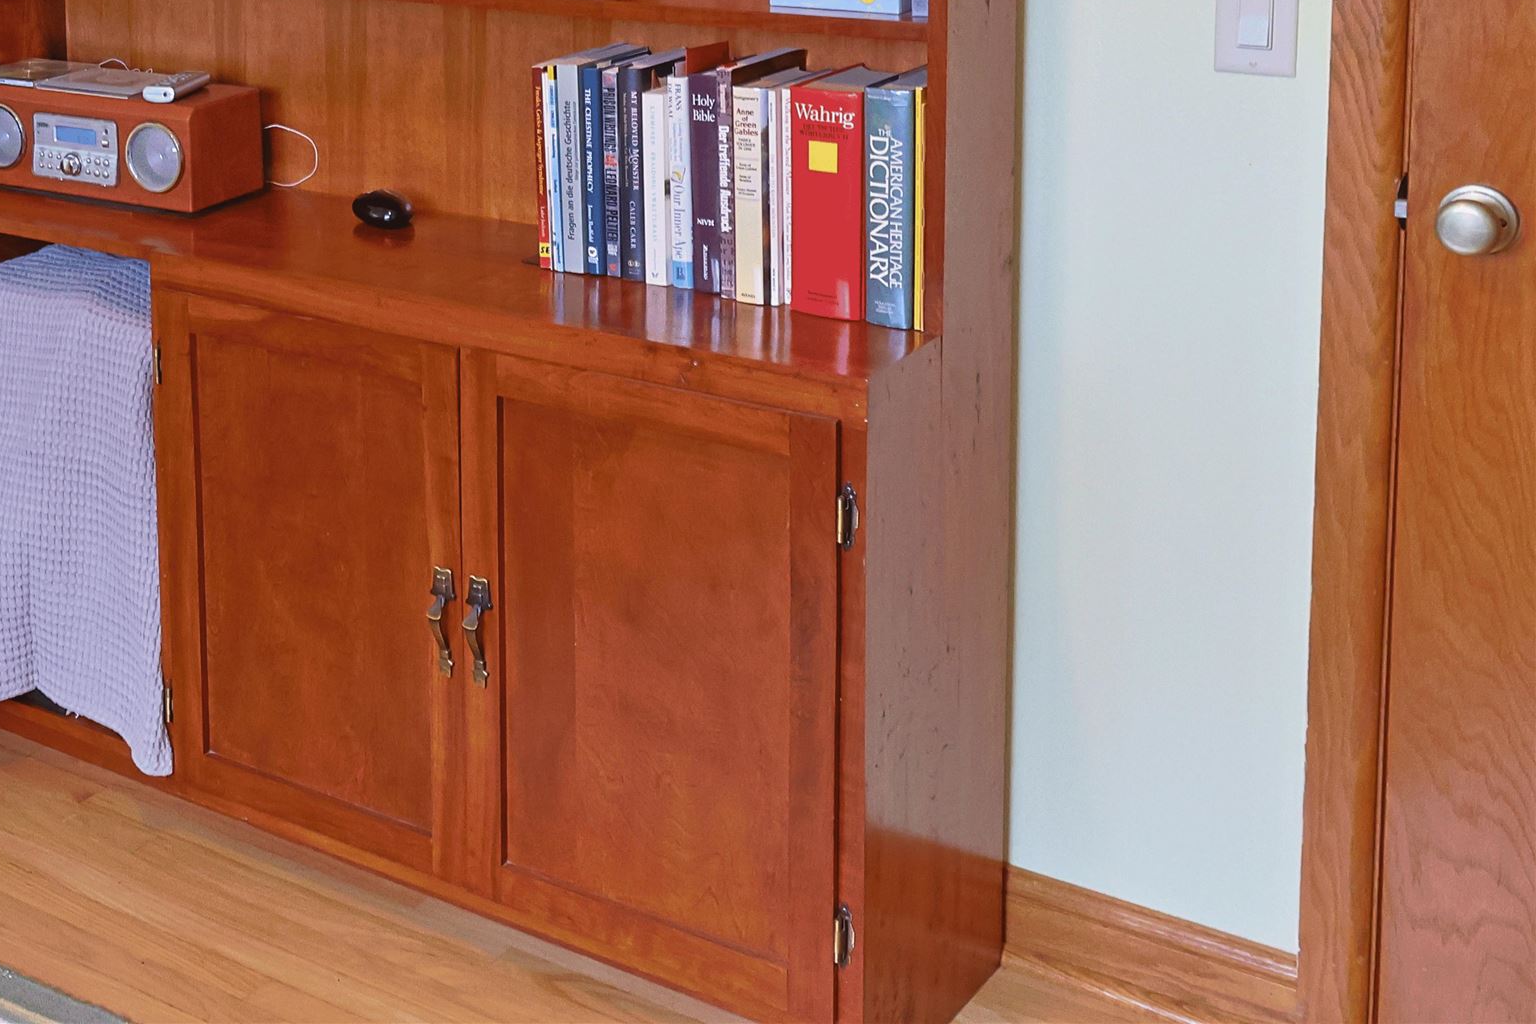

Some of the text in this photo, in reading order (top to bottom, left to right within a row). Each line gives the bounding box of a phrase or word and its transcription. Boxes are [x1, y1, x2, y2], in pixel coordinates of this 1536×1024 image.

[604, 88, 616, 152] PRISON WRITINGS
[631, 92, 638, 104] MY
[692, 94, 715, 108] Holy
[693, 108, 715, 122] Bible
[794, 102, 855, 130] Wahrig
[734, 128, 758, 136] Gables
[564, 101, 576, 240] Fragen an die deutsche Geschichte
[629, 149, 640, 190] MONSTER
[719, 126, 732, 232] Der treffende Ausdruck
[606, 168, 618, 242] LEONARD PELTIER
[672, 184, 684, 258] Our Inner Ape
[869, 136, 889, 287] DICTIONARY
[890, 138, 903, 288] AMERICAN HERITAGE
